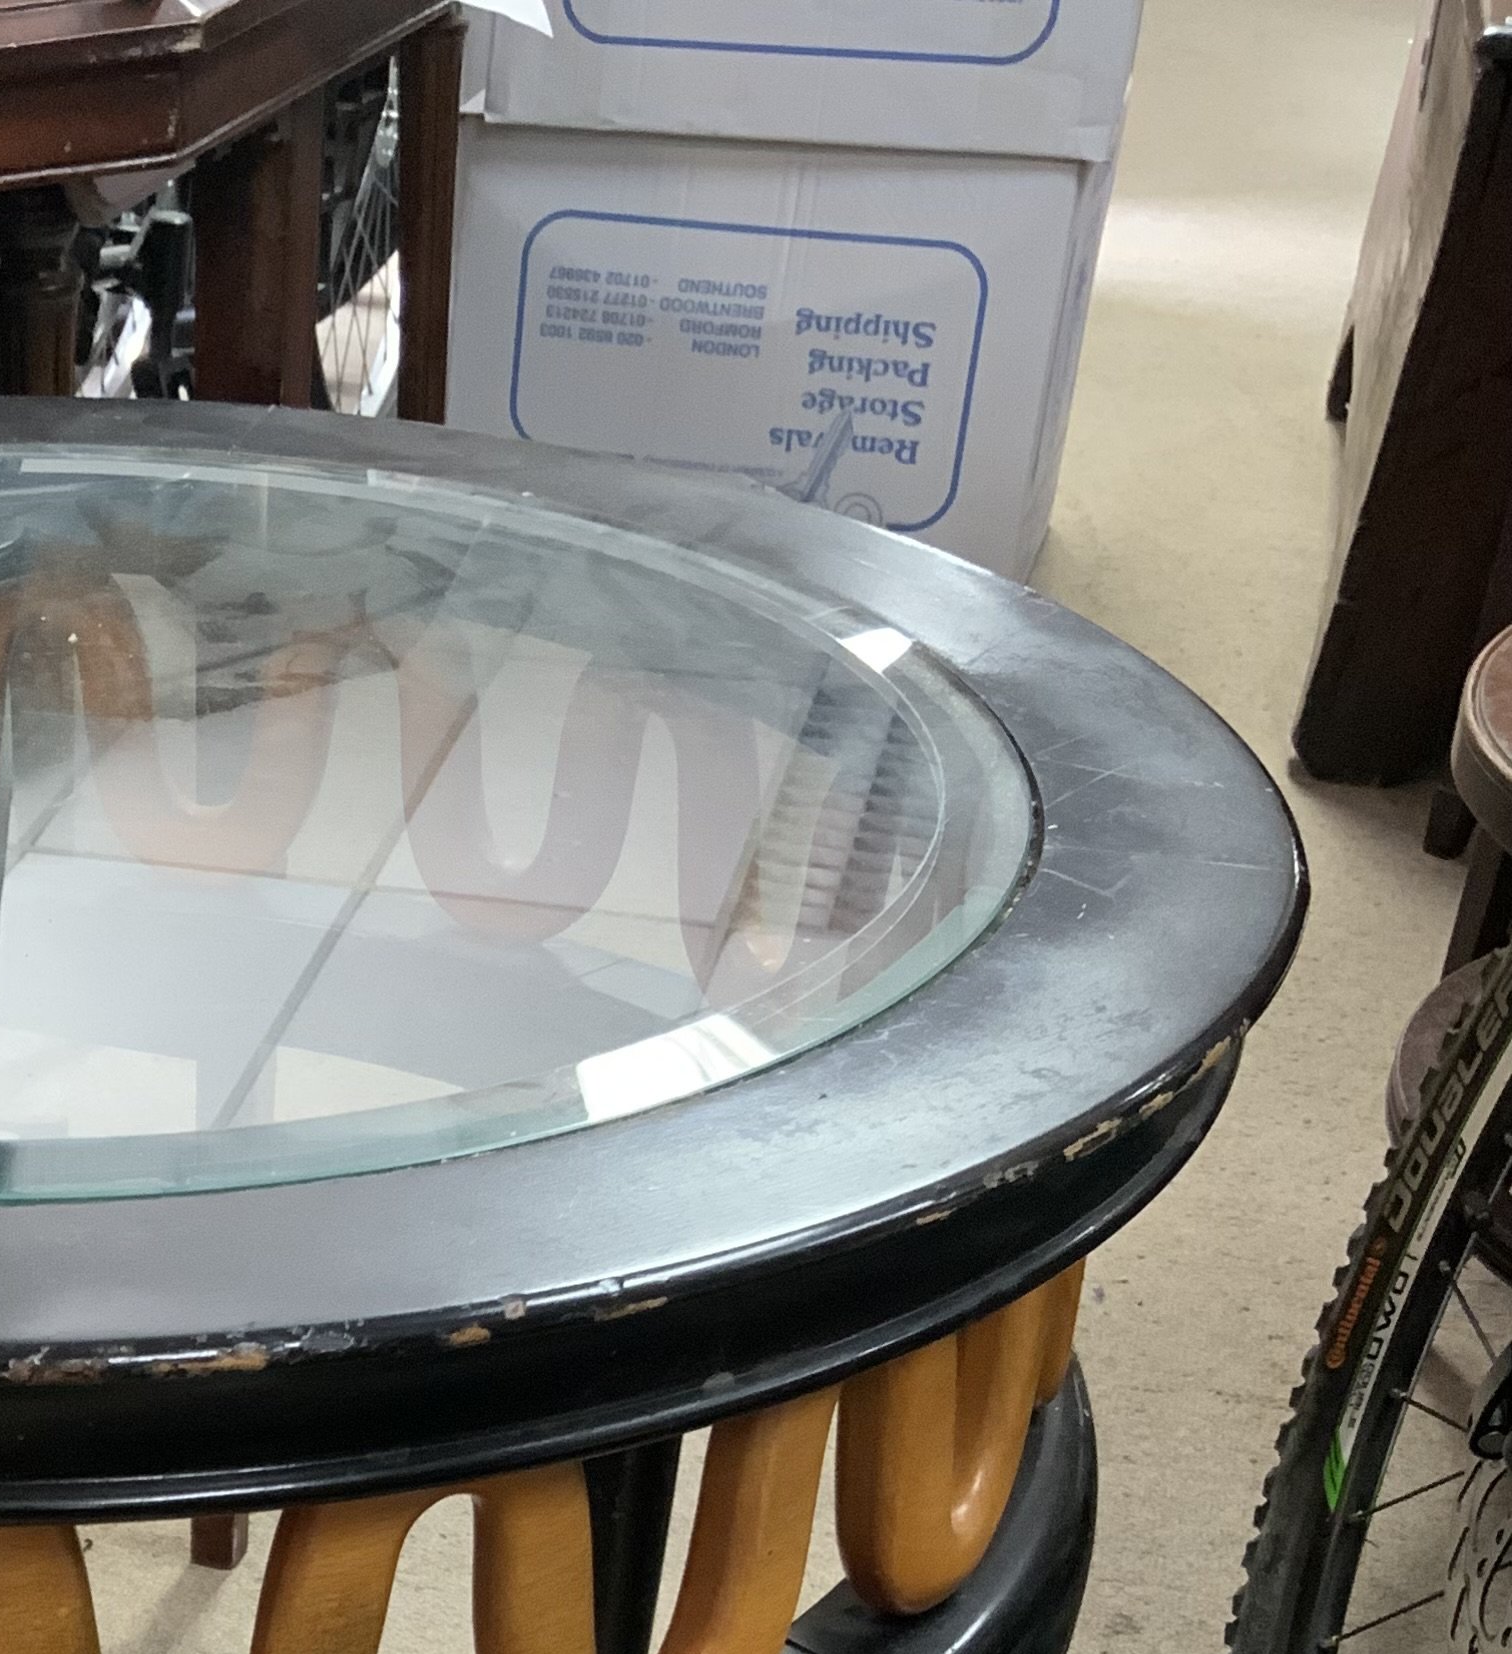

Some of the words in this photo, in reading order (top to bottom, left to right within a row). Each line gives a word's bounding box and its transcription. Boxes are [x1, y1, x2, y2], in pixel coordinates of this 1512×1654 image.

[678, 277, 768, 299] SOUTHEND
[659, 297, 765, 320] BRENTWOOD
[679, 318, 762, 340] ROMFORD
[795, 307, 936, 349] Shipping
[691, 338, 760, 358] LONDON
[808, 348, 930, 388] Packing
[801, 387, 925, 427] Storage
[769, 427, 920, 465] Remals
